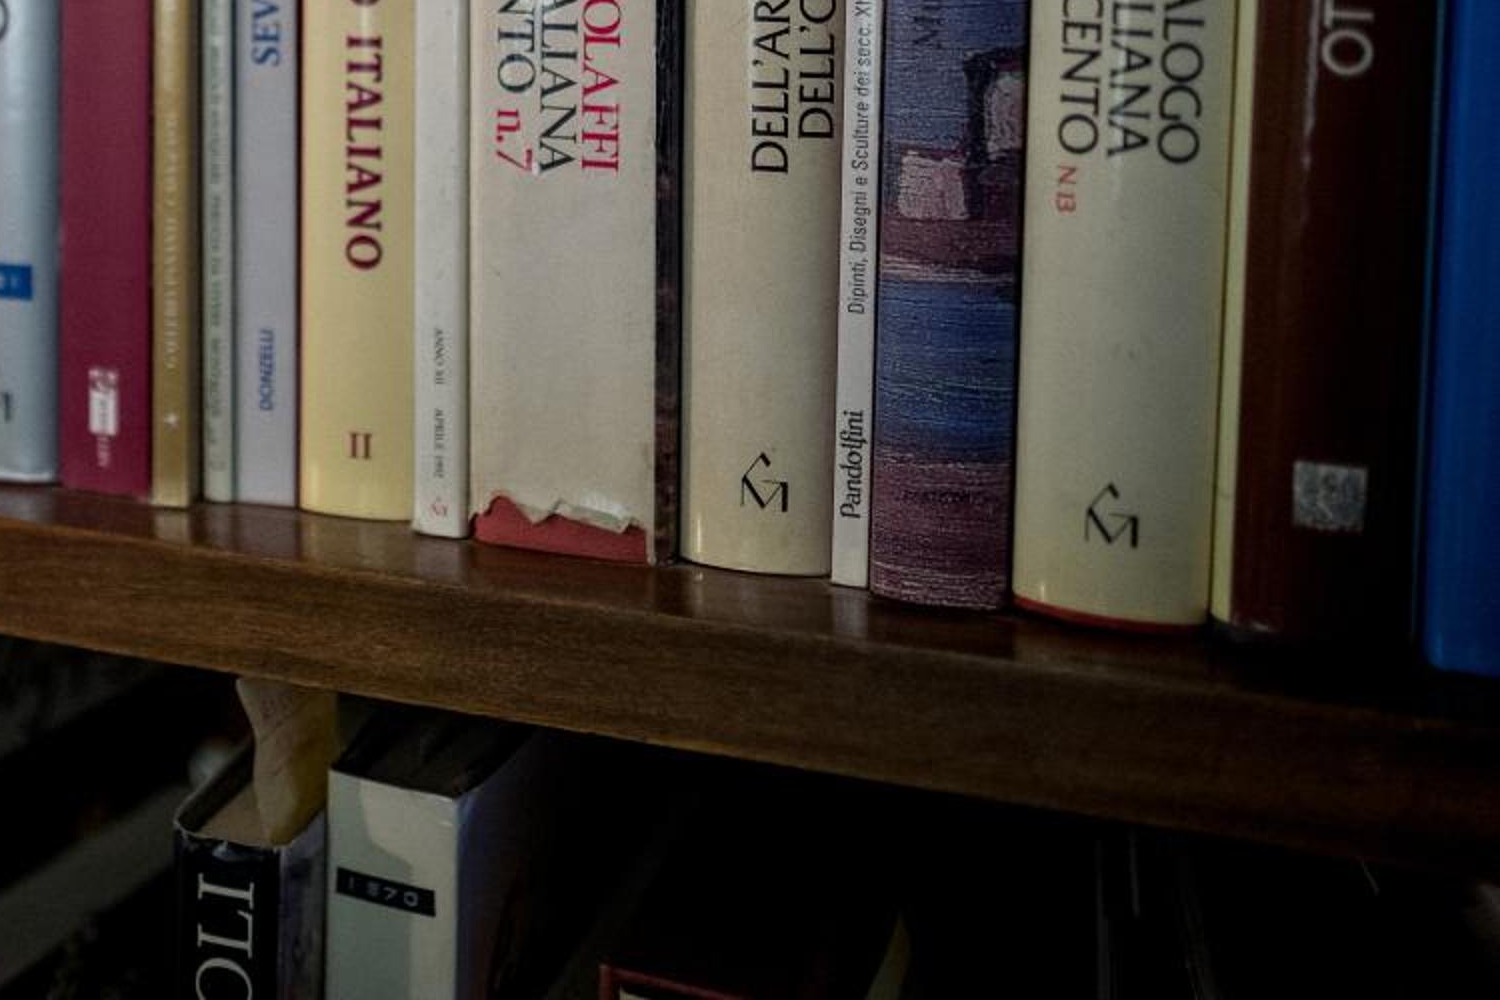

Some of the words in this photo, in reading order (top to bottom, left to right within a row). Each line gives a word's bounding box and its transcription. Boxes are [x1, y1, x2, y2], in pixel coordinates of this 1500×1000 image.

[853, 71, 872, 97] dei
[345, 35, 385, 271] ITALIANO
[850, 102, 871, 171] Sculture
[854, 177, 868, 186] e
[849, 192, 872, 253] Disegni
[846, 259, 869, 315] Dipinti,
[838, 410, 869, 519] Pandolfini
